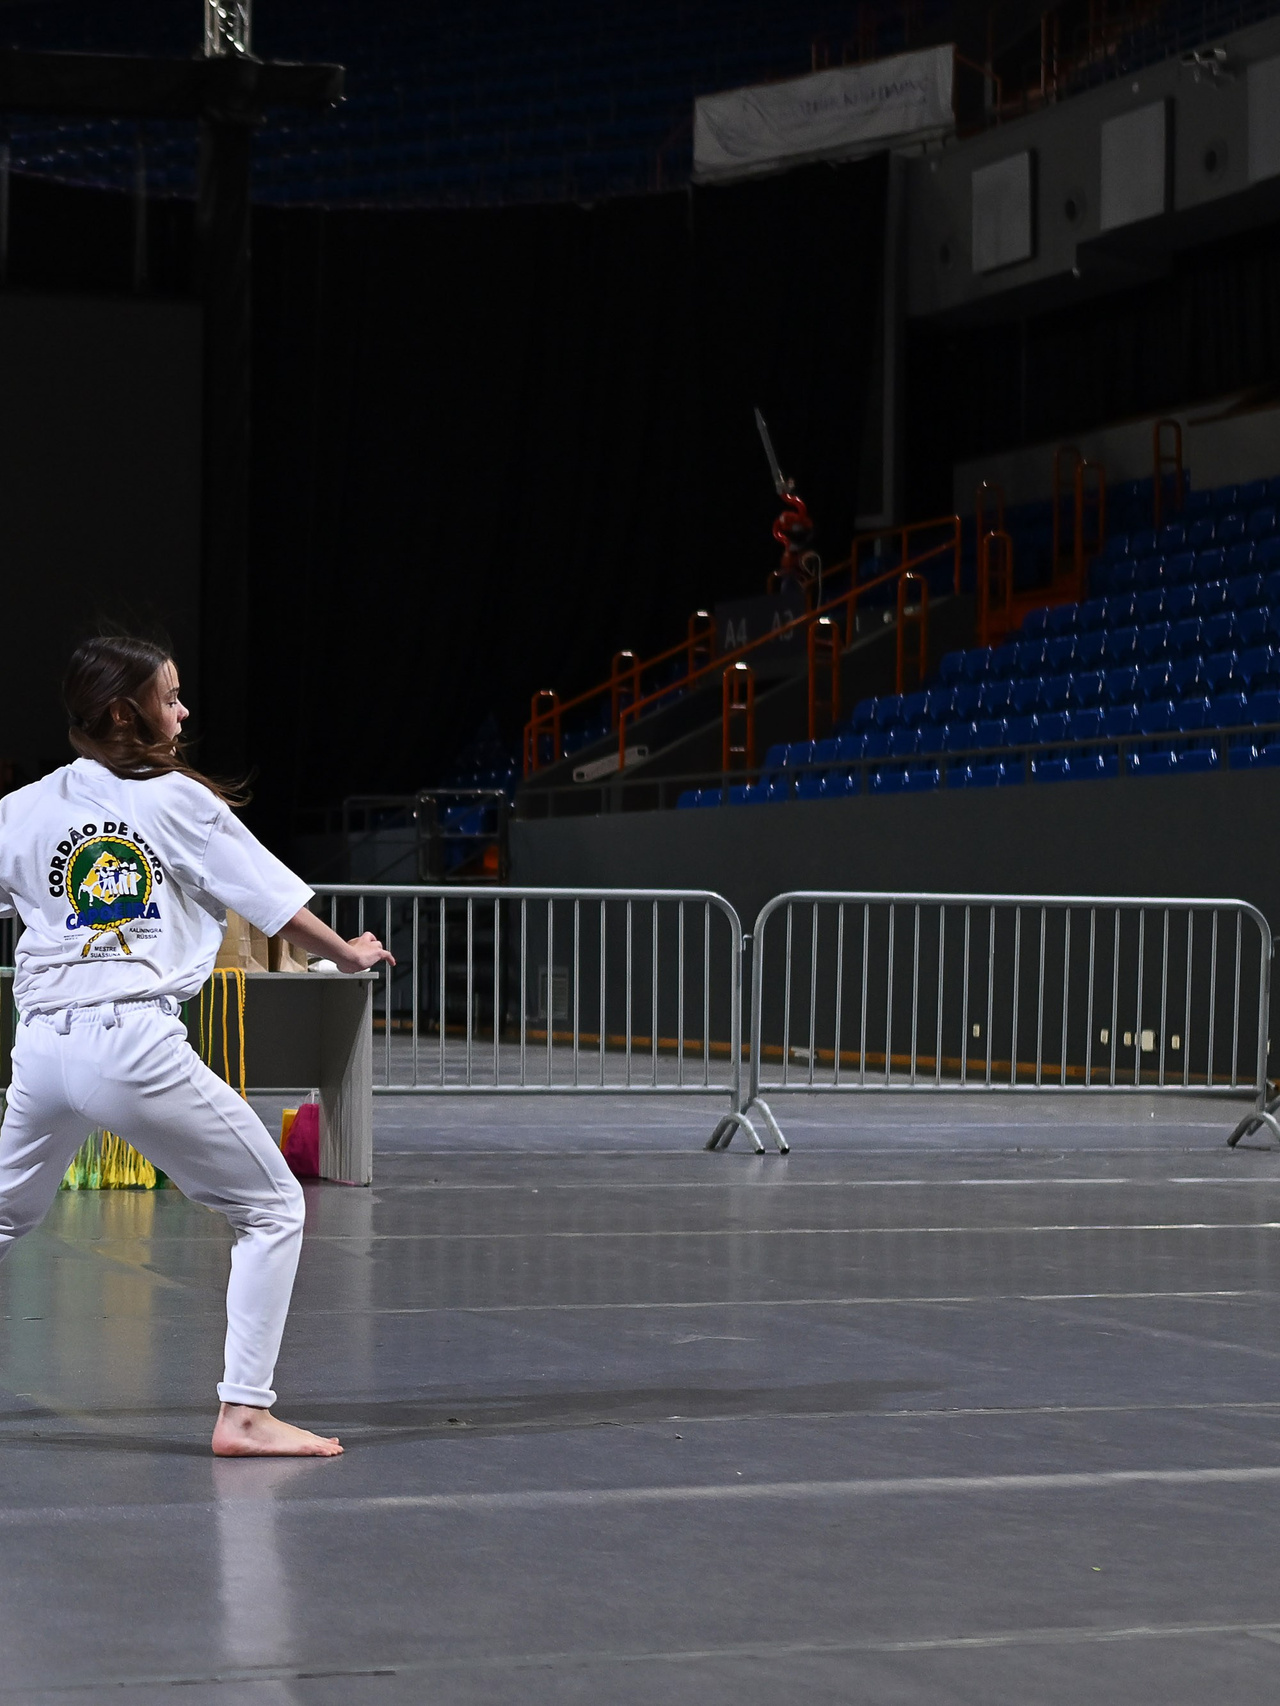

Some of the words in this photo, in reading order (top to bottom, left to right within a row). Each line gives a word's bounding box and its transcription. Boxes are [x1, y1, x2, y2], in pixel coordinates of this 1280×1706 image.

[724, 616, 747, 649] A4
[103, 821, 128, 836] DE
[65, 902, 161, 931] CAPOEIRA
